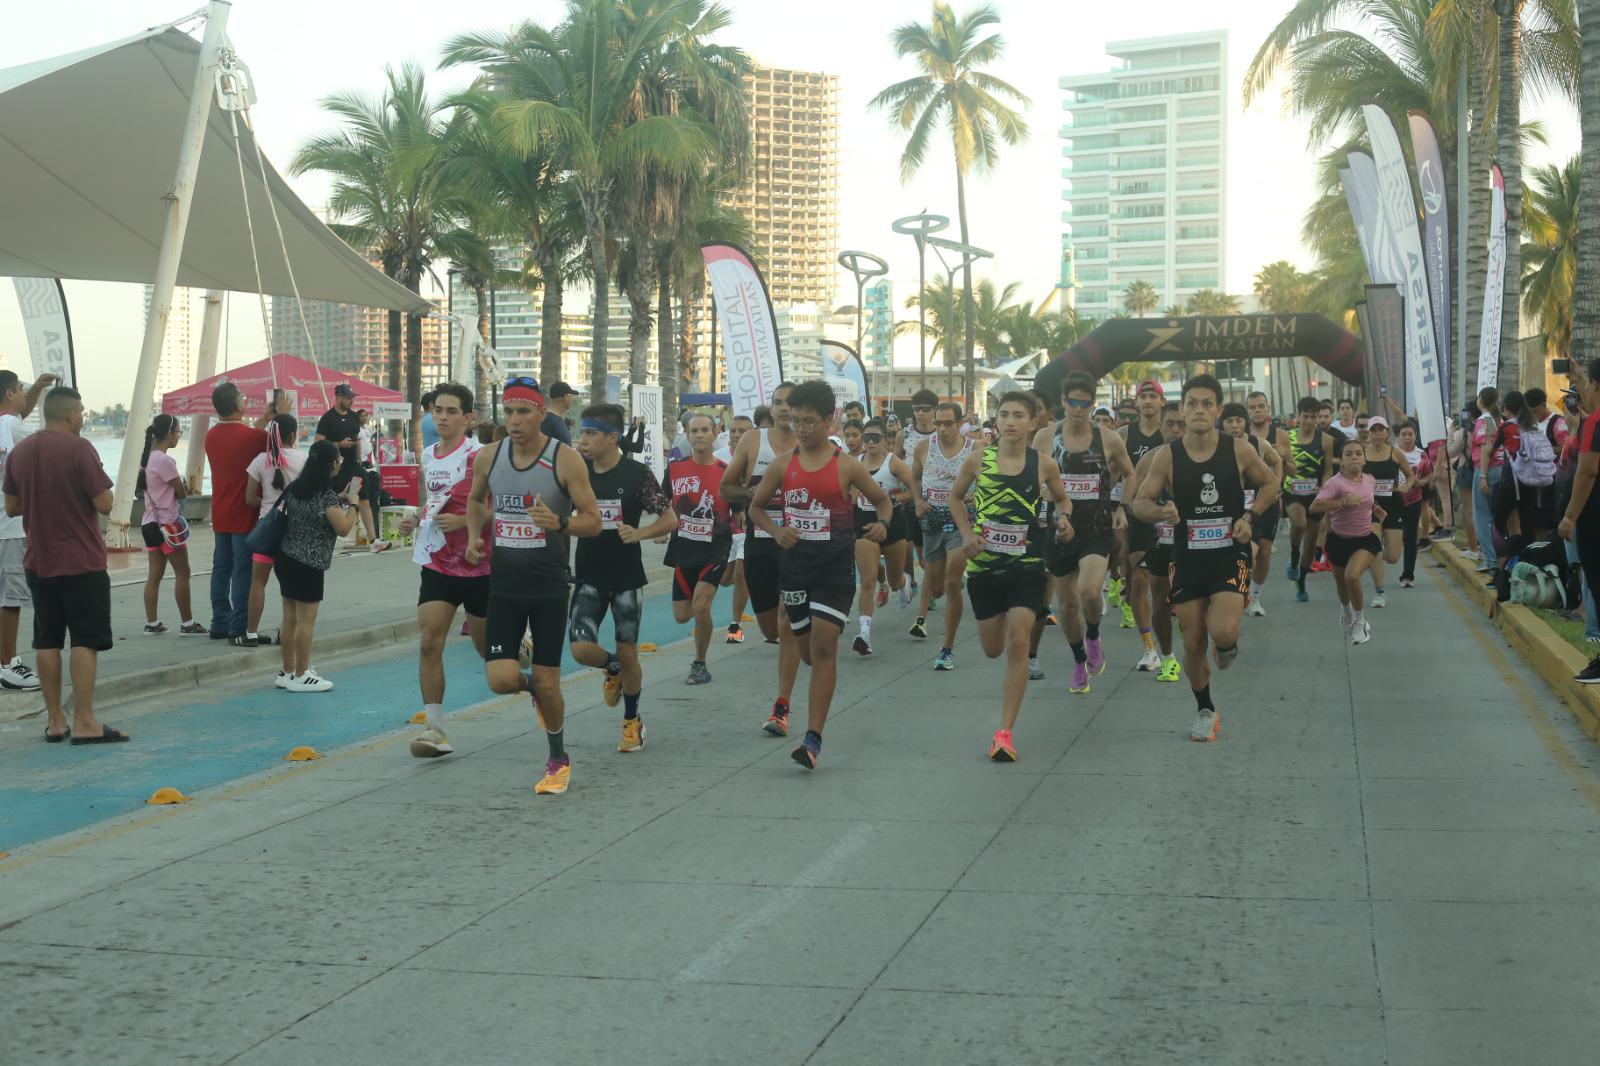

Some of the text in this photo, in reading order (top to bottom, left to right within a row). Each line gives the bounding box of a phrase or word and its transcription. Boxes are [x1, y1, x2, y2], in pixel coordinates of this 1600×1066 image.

[1195, 316, 1297, 337] IMDEM
[723, 283, 759, 412] HOSPITAL
[643, 430, 653, 466] RSA
[1070, 482, 1091, 491] 738
[1195, 505, 1224, 514] SPACE
[688, 524, 705, 533] 664
[795, 519, 818, 530] 351
[506, 525, 533, 537] 716
[1199, 528, 1223, 538] 508
[992, 533, 1017, 544] 409
